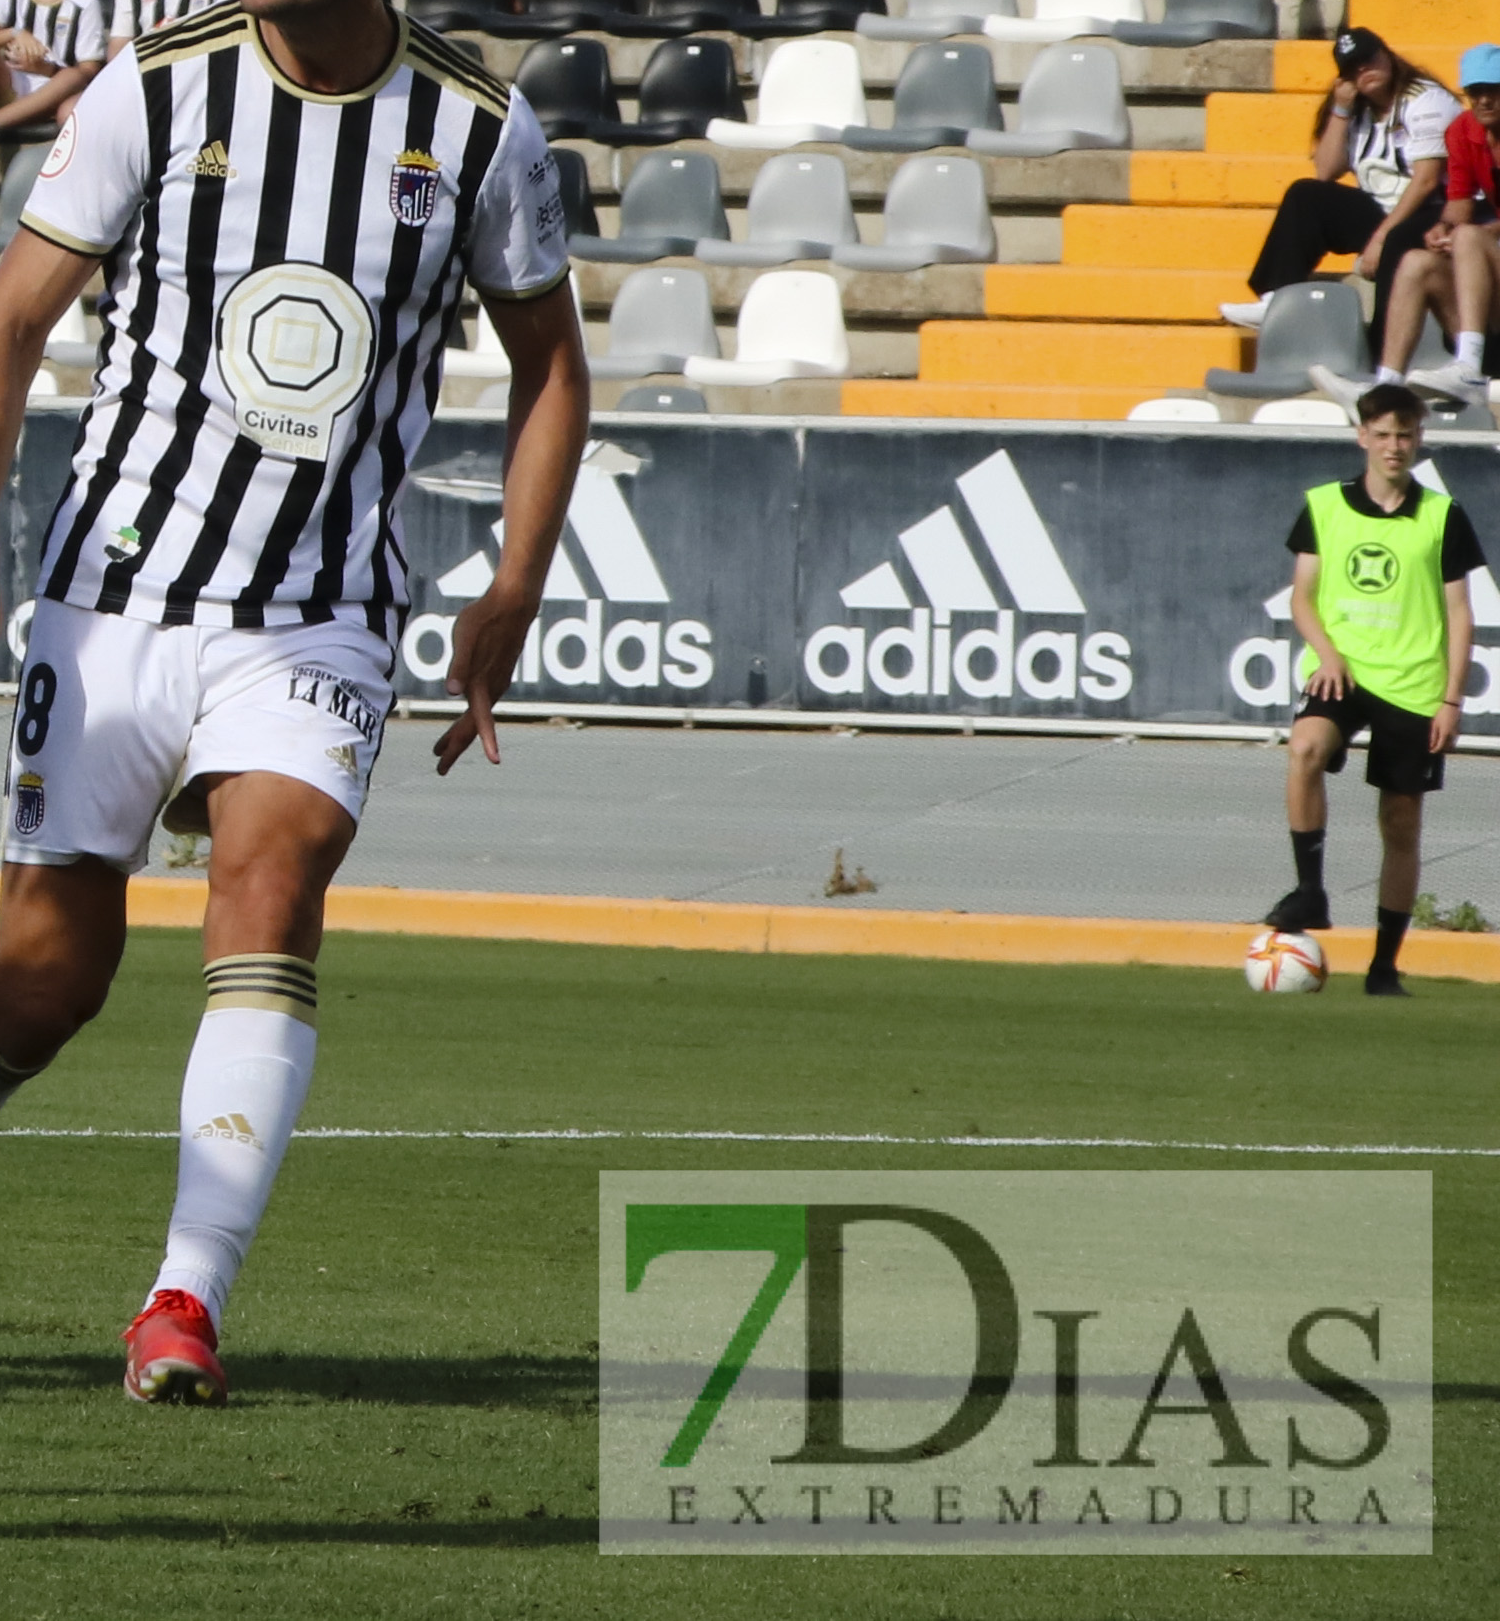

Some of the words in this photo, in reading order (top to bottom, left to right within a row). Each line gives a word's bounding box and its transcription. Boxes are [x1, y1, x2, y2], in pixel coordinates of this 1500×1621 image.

[244, 408, 319, 439] Civitas
[804, 608, 1133, 700] adidas
[18, 662, 57, 756] 8
[288, 677, 319, 707] LA
[326, 683, 377, 745] MAR
